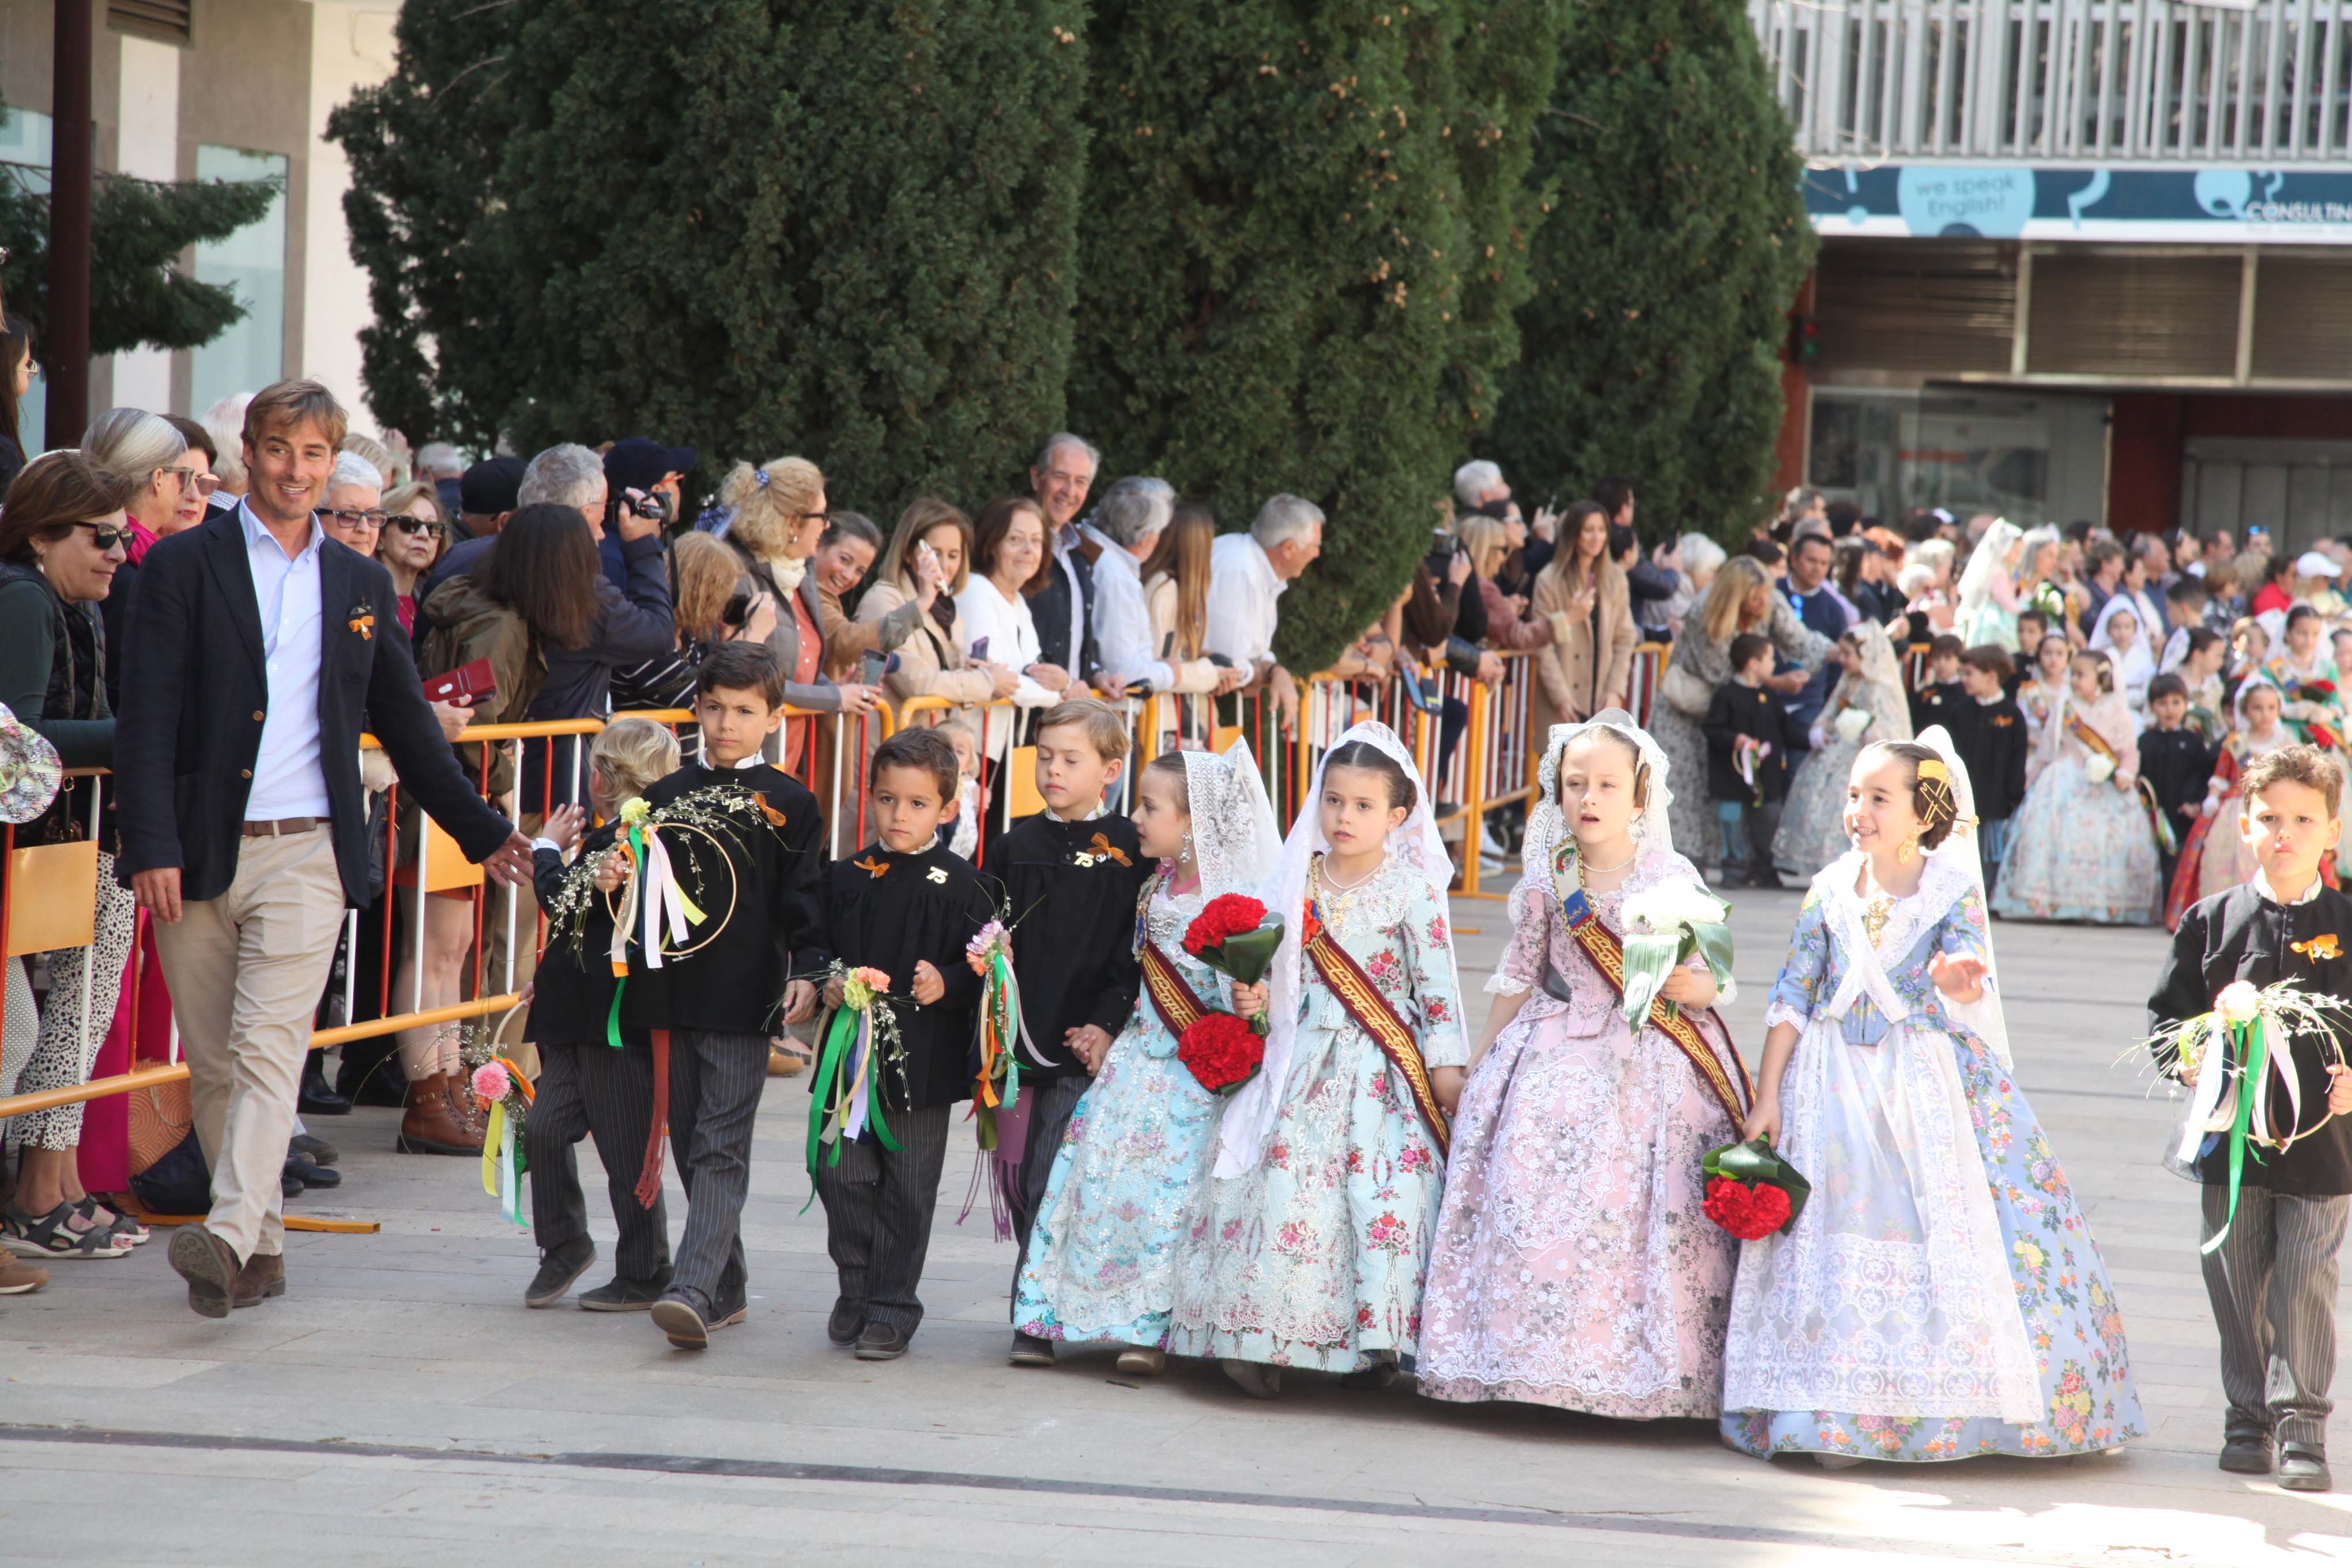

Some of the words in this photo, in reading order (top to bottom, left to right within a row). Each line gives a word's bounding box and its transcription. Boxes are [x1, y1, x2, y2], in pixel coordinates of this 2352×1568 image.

[1914, 181, 1947, 196] we
[1953, 173, 2014, 196] speak
[1927, 195, 2004, 218] English!
[1074, 851, 1094, 868] 75
[926, 866, 948, 884] 75
[1152, 977, 1186, 1018] Cort
[1328, 968, 1369, 1011] Cort
